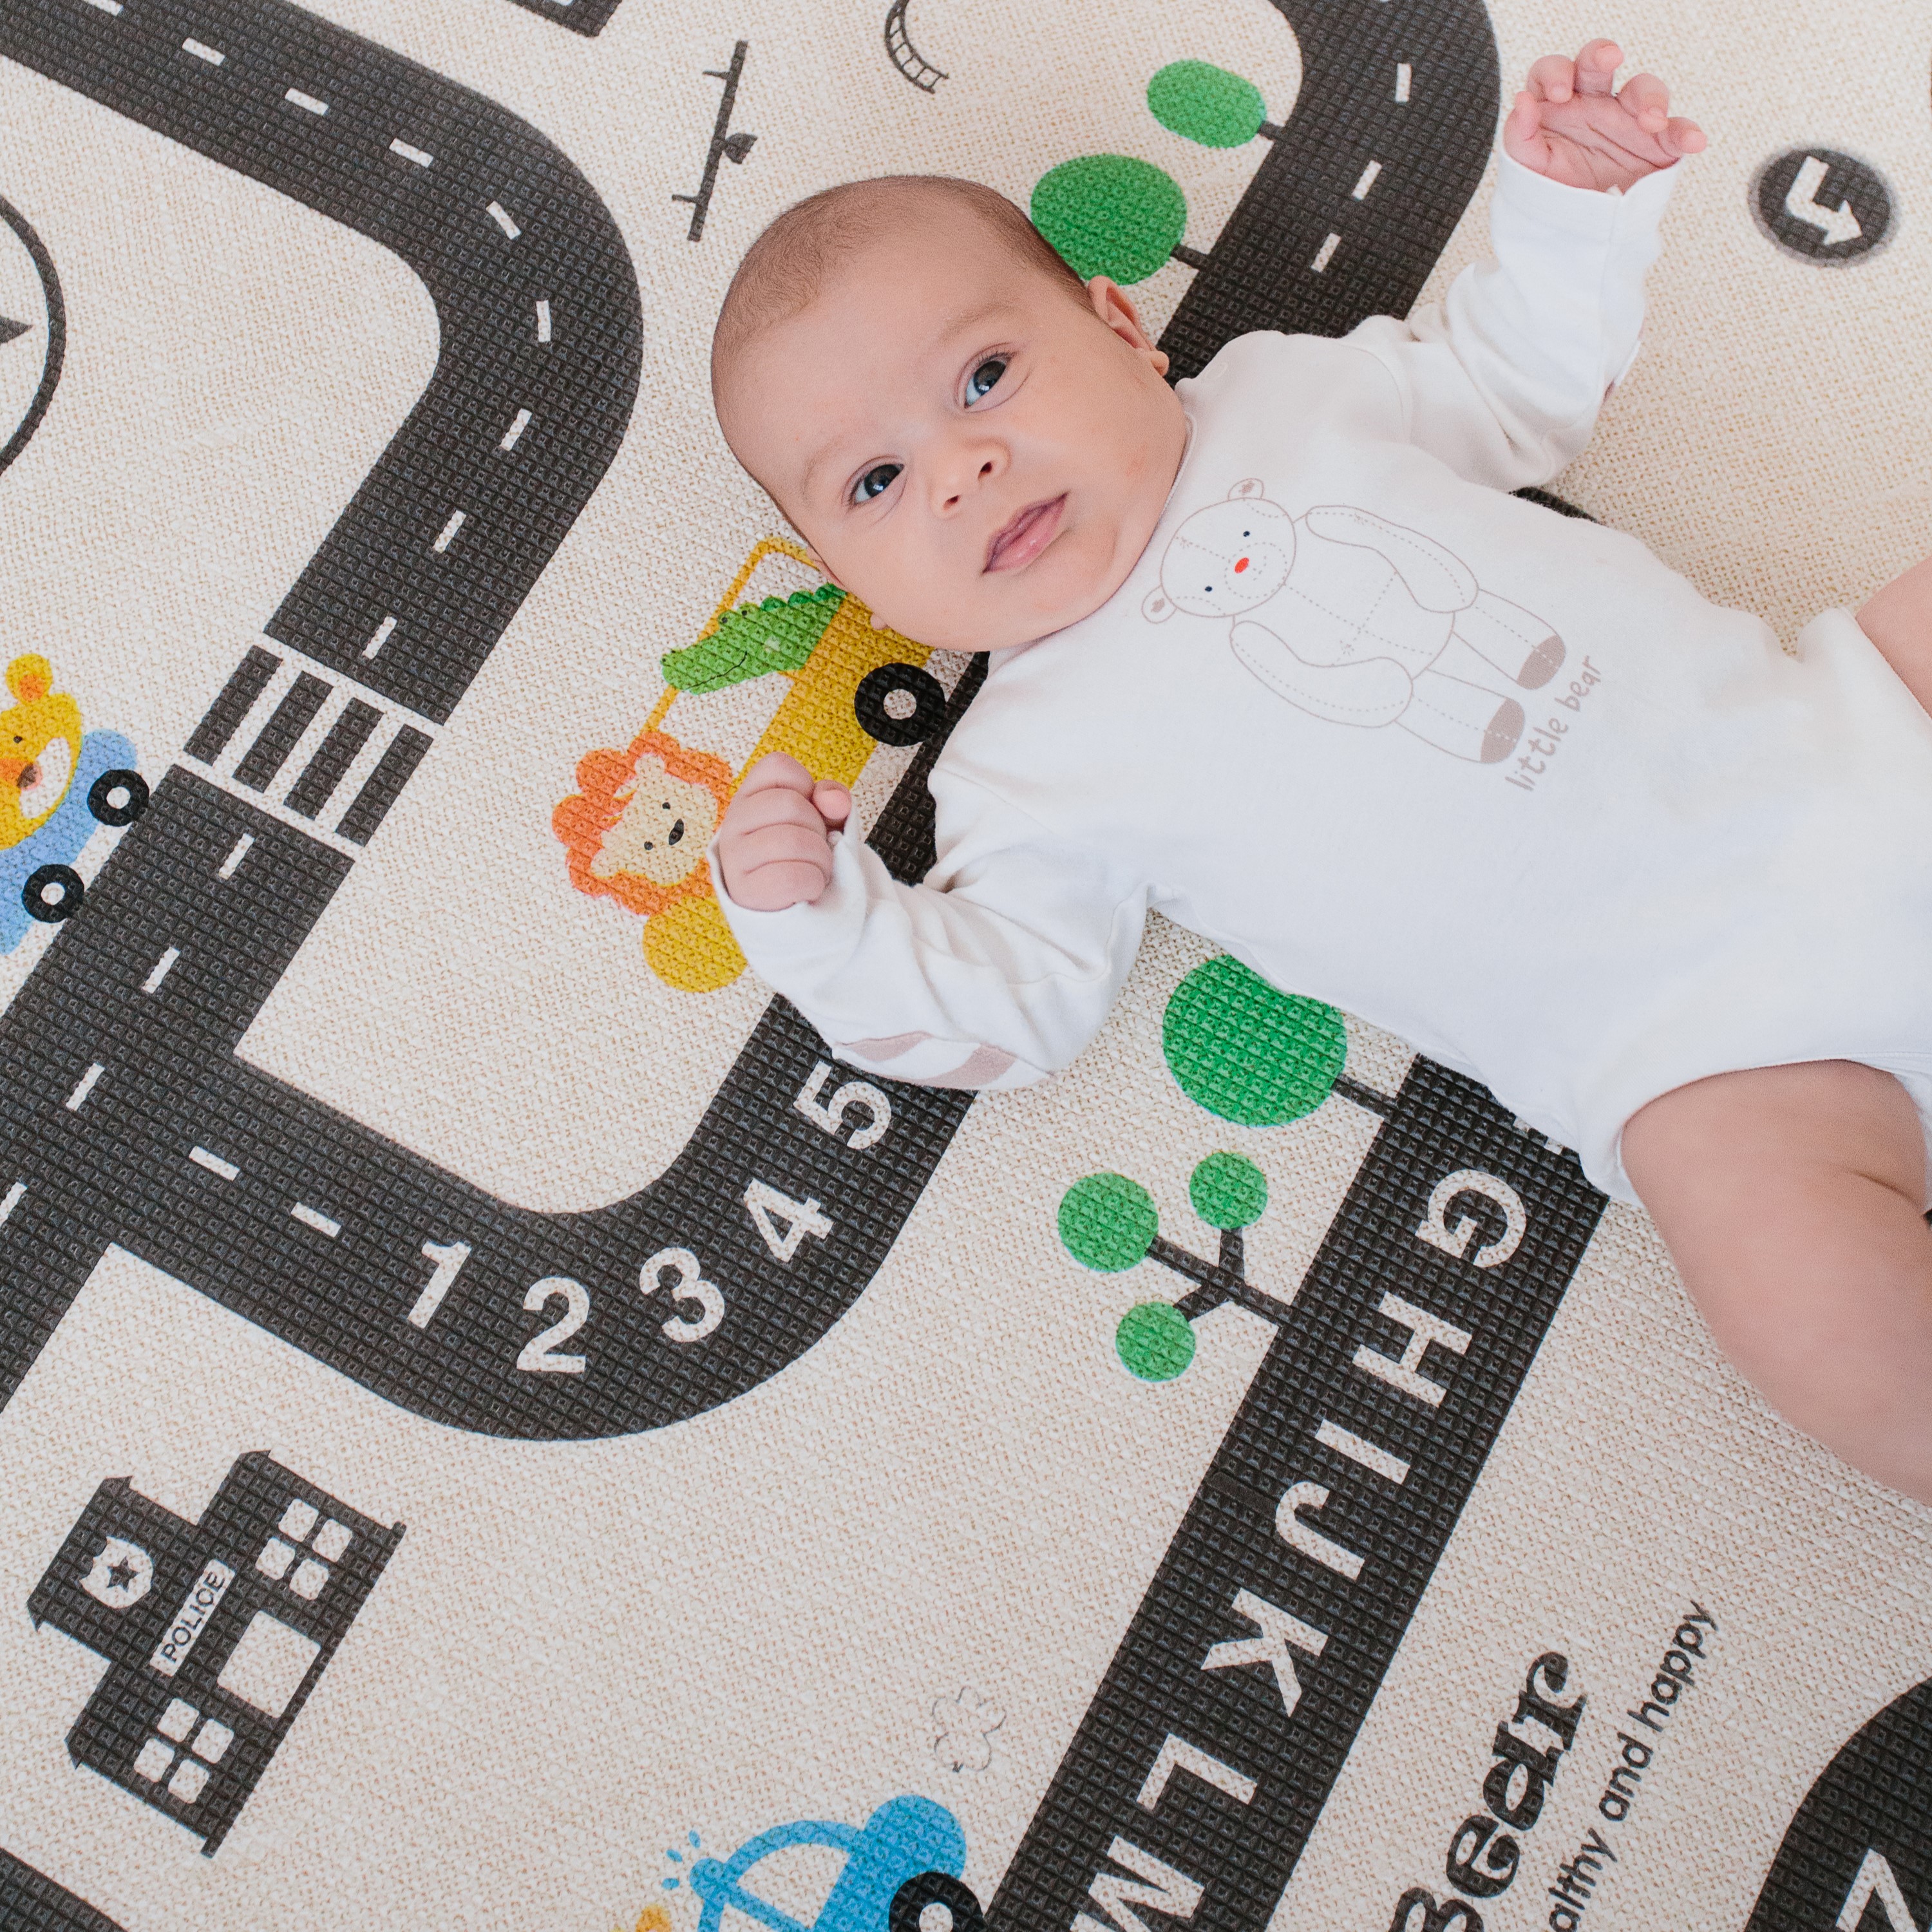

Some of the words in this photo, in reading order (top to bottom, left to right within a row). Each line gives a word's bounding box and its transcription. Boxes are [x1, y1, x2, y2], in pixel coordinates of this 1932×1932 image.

[1504, 717, 1569, 791] little
[1554, 654, 1602, 712] bear
[407, 1240, 472, 1329] 1
[516, 1276, 591, 1374] 2
[639, 1247, 726, 1343] 3
[743, 1178, 834, 1263] 4
[793, 1060, 893, 1150] 5
[1415, 1169, 1527, 1267] G
[1352, 1291, 1472, 1407] H
[1314, 1419, 1411, 1484] I
[1275, 1481, 1365, 1580] J
[161, 1571, 225, 1663] POLICE
[1201, 1587, 1329, 1718] K
[1598, 1731, 1654, 1823] and
[1627, 1600, 1719, 1732] happy
[1136, 1732, 1258, 1810] L
